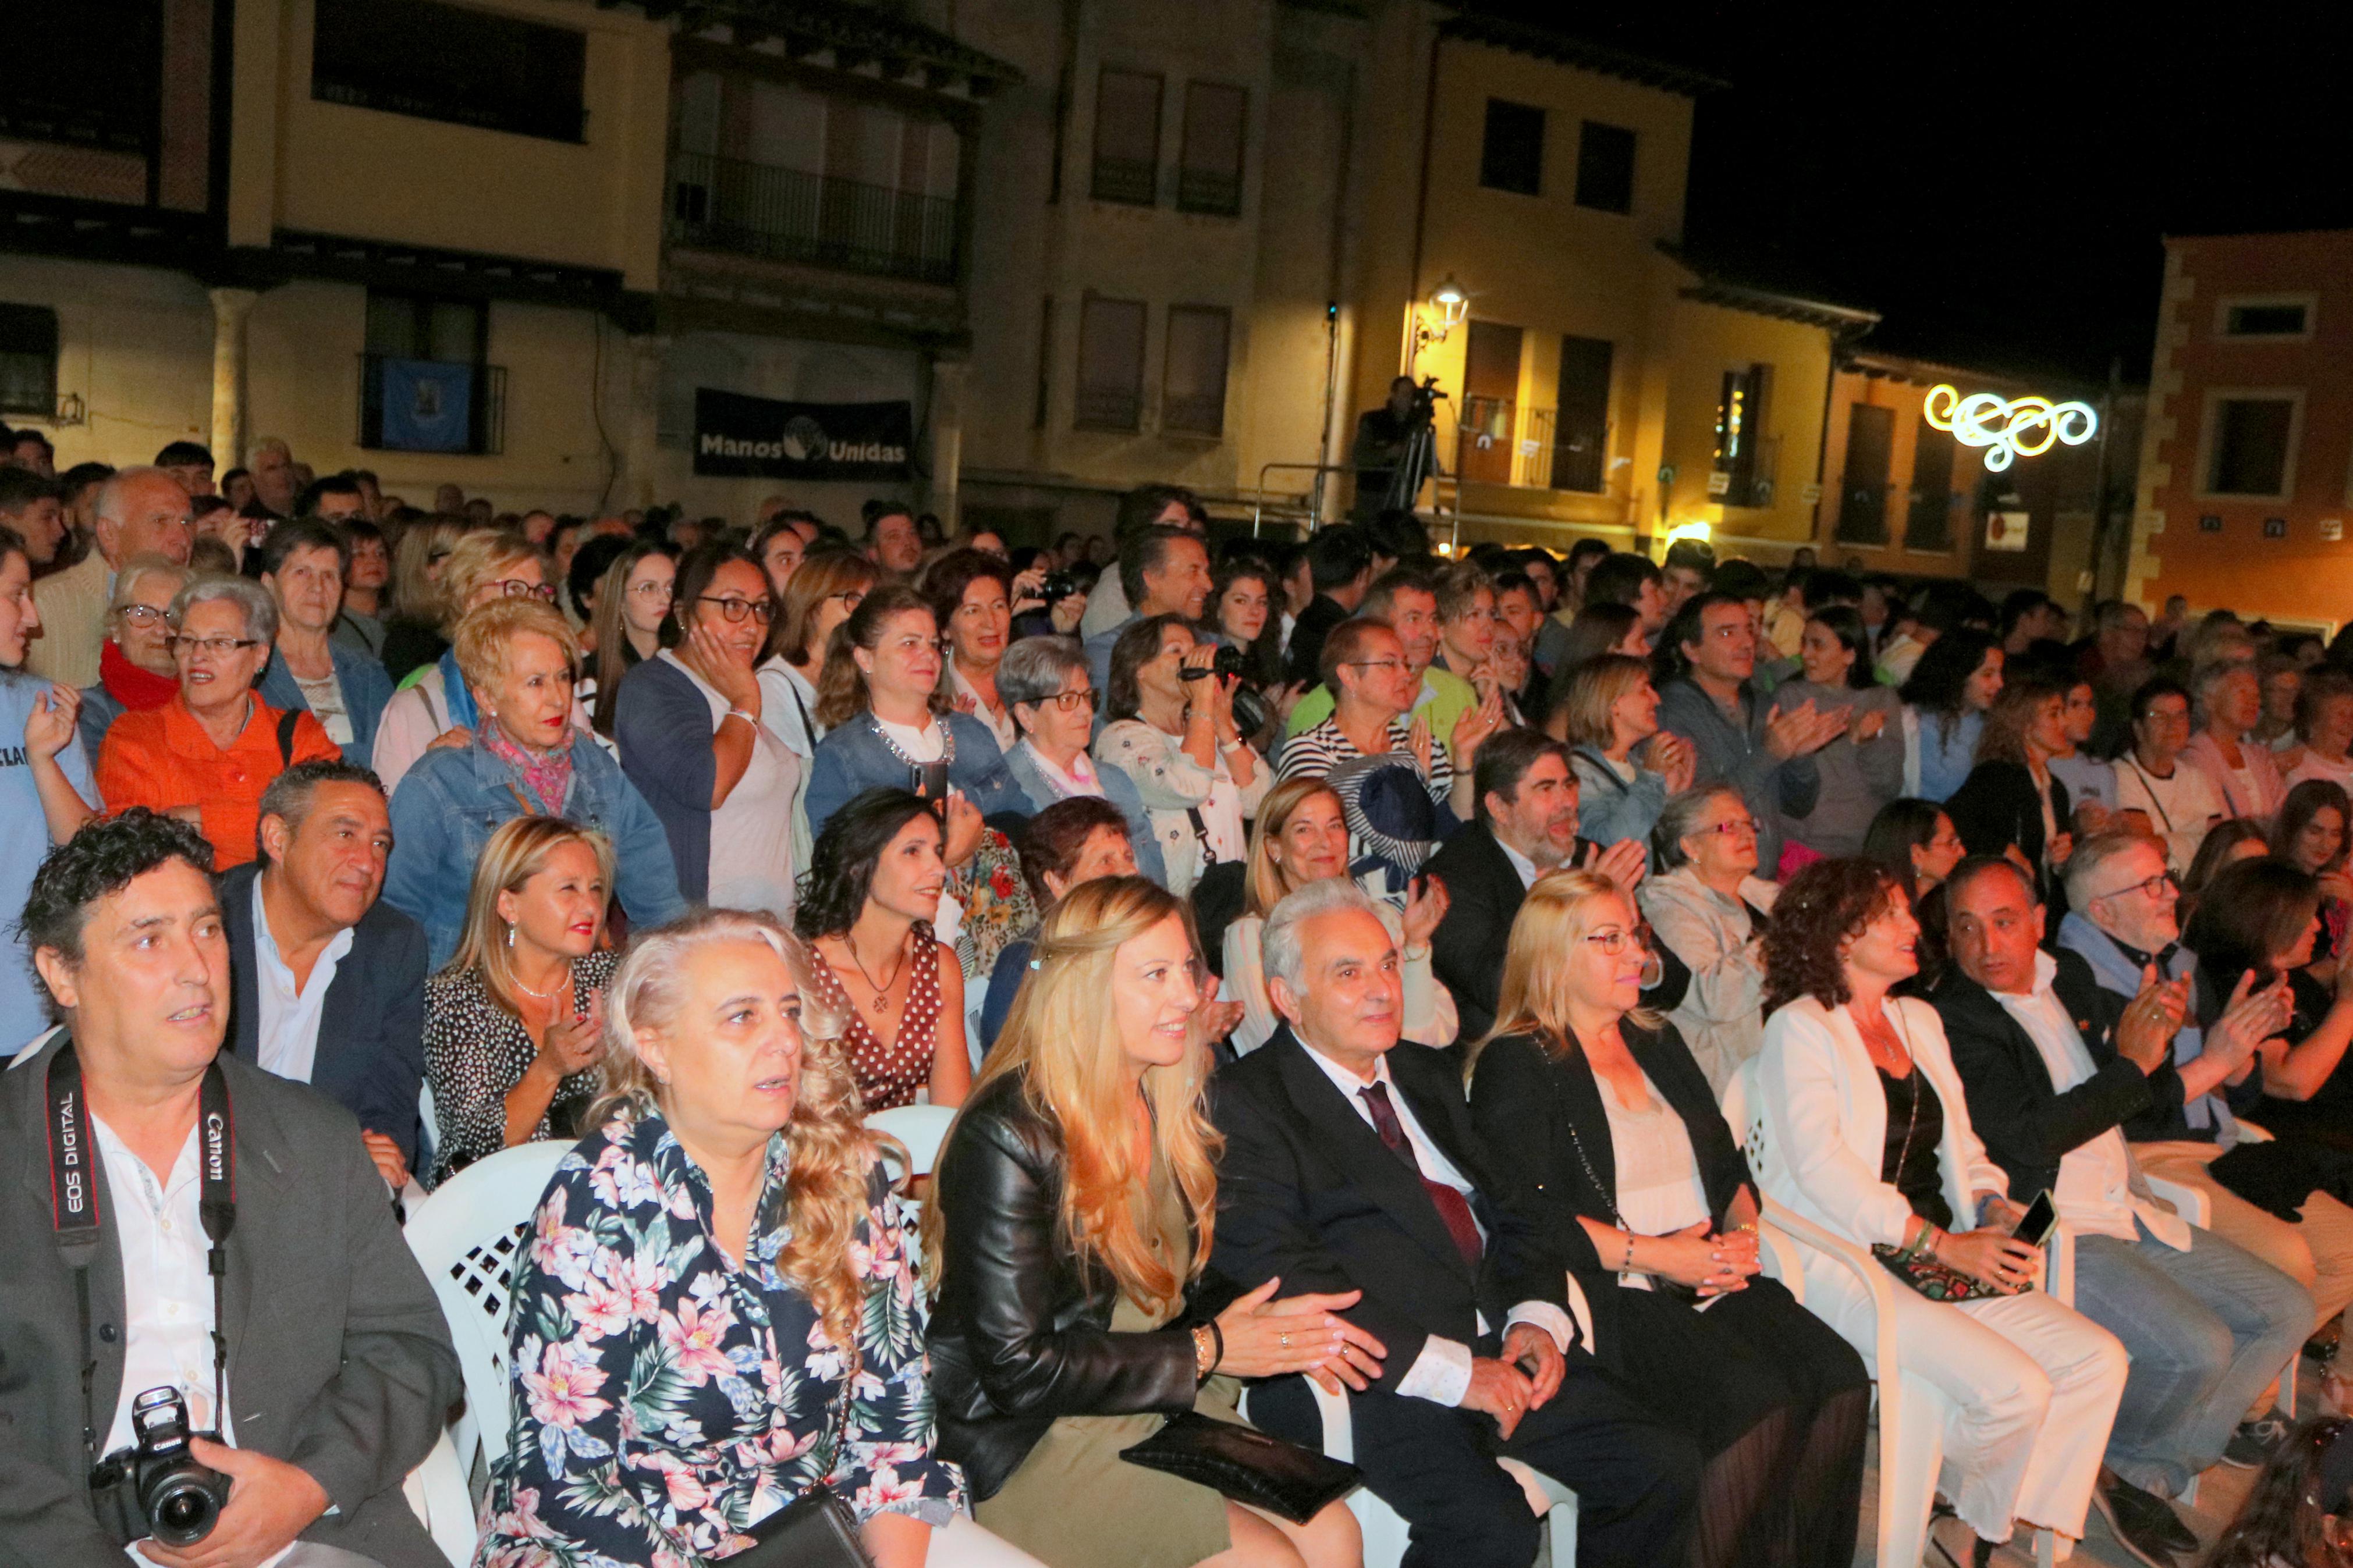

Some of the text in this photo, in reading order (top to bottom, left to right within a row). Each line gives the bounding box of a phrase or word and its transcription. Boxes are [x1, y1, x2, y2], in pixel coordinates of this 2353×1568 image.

[701, 433, 906, 463] Manos Unidas
[60, 1092, 83, 1213] EOS DIGITAL
[207, 1112, 224, 1181] Canon
[153, 1437, 182, 1450] Canon
